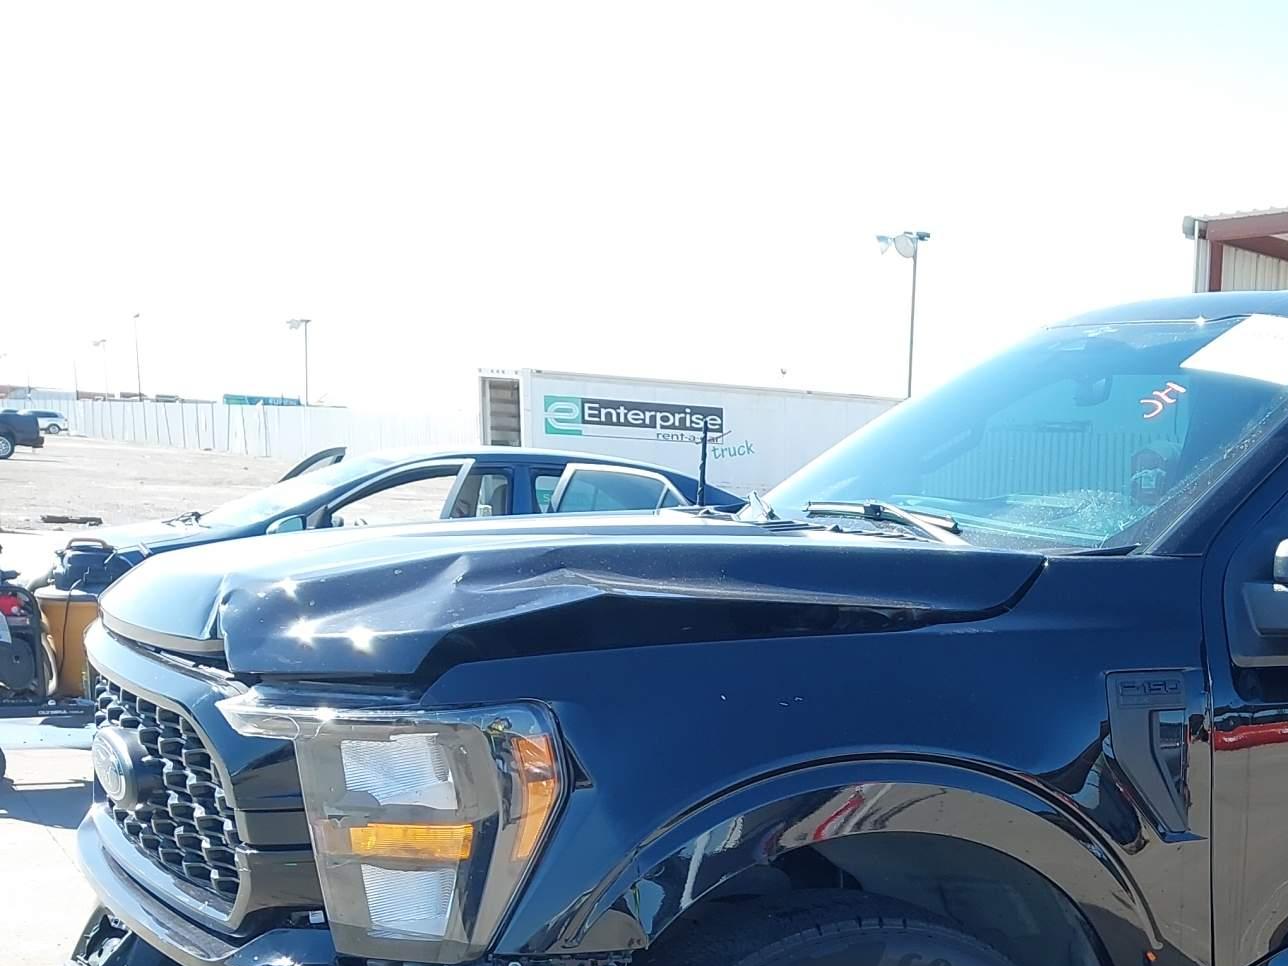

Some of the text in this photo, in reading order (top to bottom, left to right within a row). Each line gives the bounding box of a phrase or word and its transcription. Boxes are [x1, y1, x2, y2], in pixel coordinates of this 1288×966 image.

[583, 403, 722, 432] Enterprise
[656, 432, 720, 444] rent-a-ar
[711, 439, 756, 460] truck
